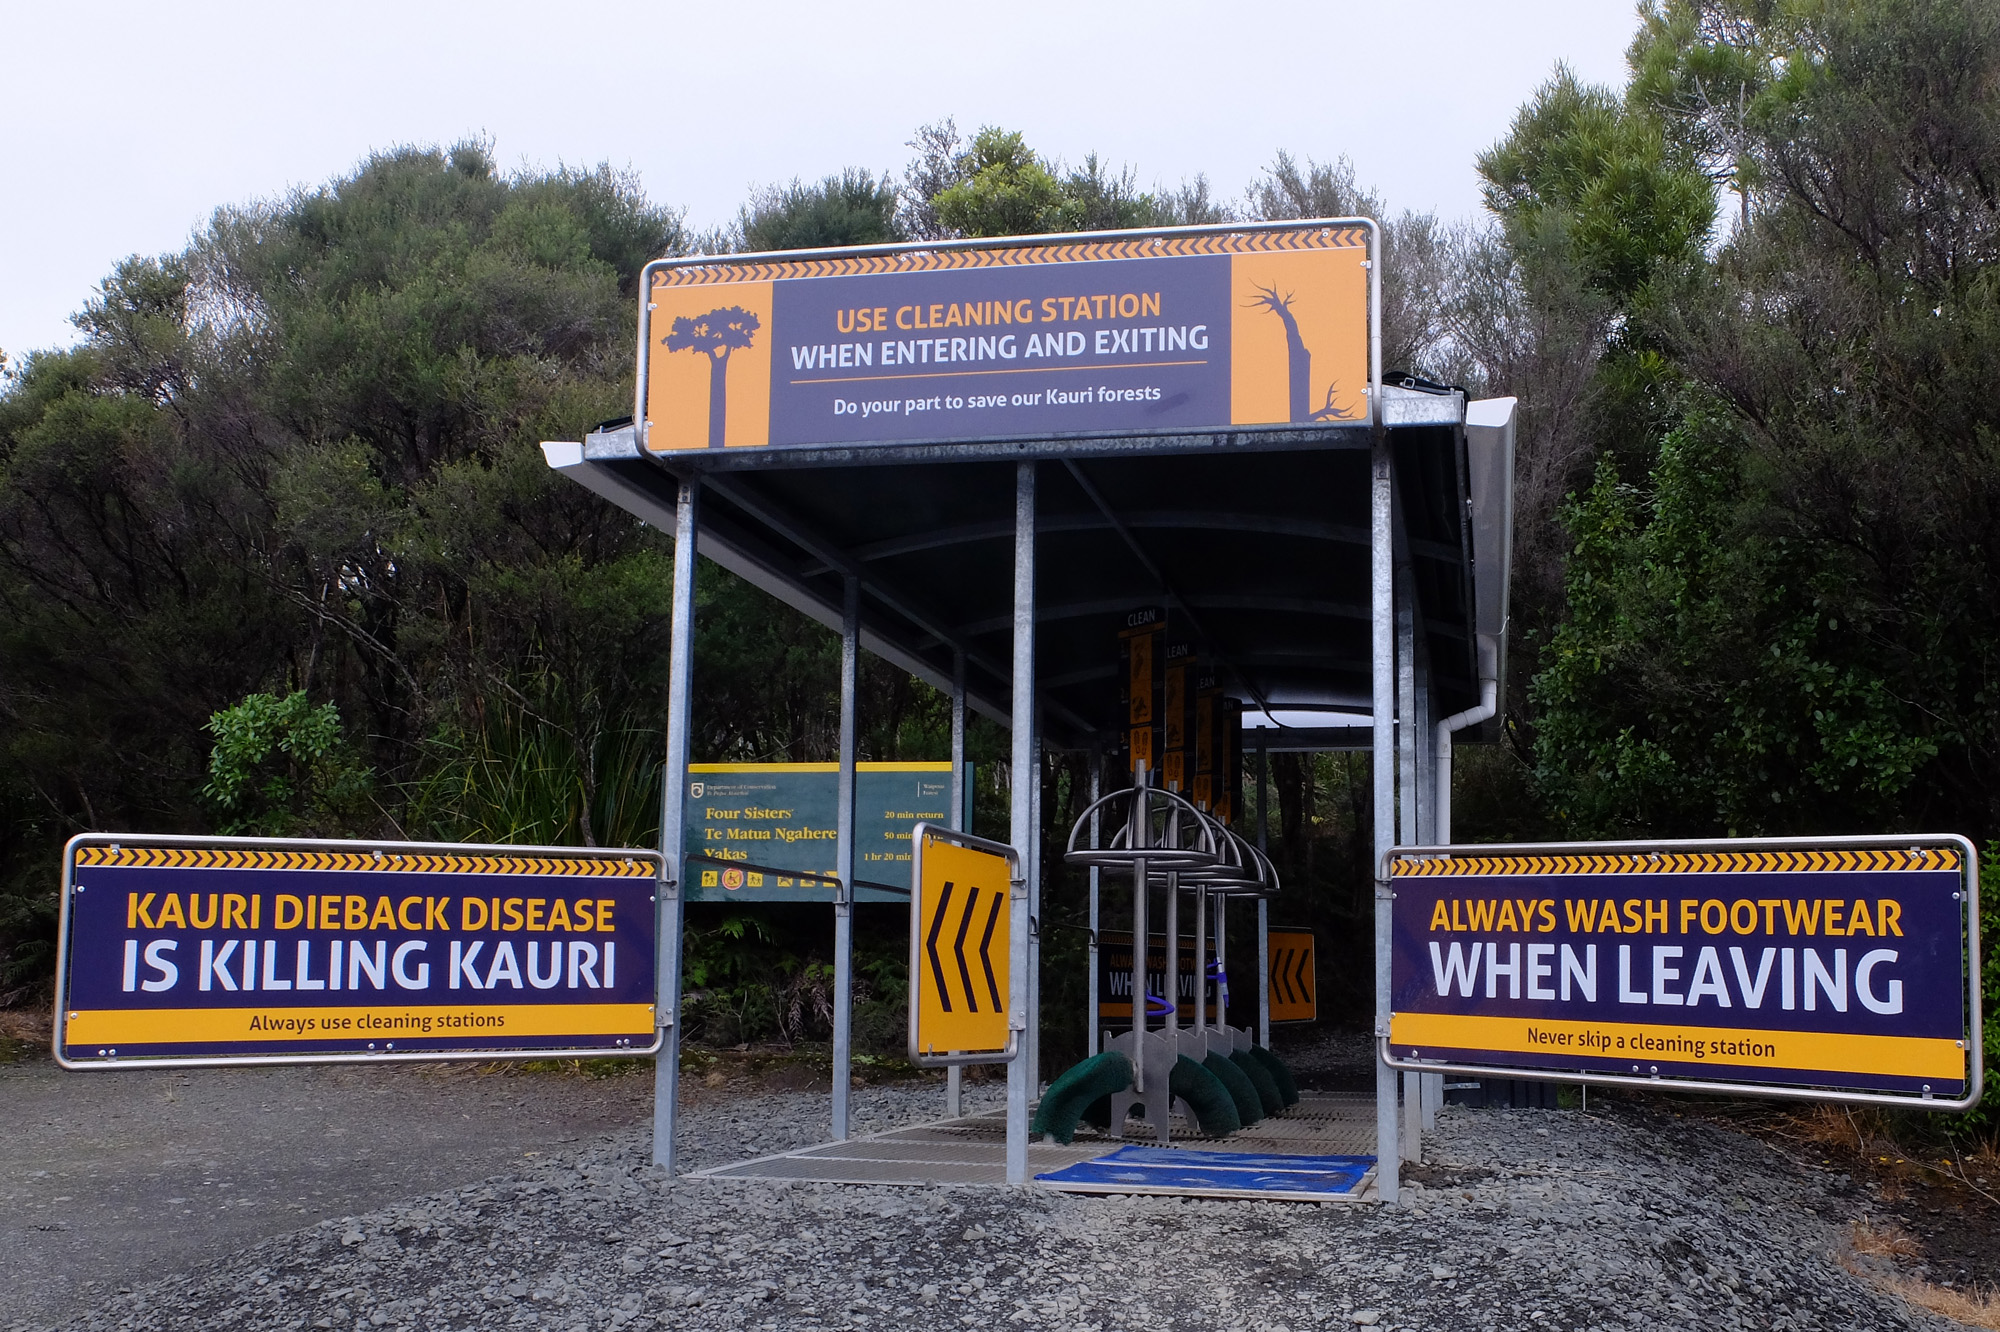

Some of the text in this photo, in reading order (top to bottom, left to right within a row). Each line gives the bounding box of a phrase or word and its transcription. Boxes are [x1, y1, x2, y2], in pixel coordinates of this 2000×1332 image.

[838, 293, 1160, 333] USE CLEANING STATION
[791, 325, 1208, 369] WHEN ENTERING AND EXITING
[835, 386, 1160, 417] Do your part to save our Kauri forests
[1127, 608, 1156, 627] CLEAN
[1166, 643, 1188, 659] LEAN
[1199, 675, 1216, 689] EAN
[705, 807, 741, 819] Four
[884, 810, 945, 819] 20 min return
[704, 826, 837, 843] Te Matua Ngahere
[884, 832, 895, 840] 50
[703, 847, 748, 860] Yakas
[871, 852, 882, 861] hr
[884, 852, 894, 861] 20
[128, 893, 615, 931] KAURI DIEBACK DISEASE
[1430, 899, 1903, 936] ALWAYS WASH FOOTWEAR
[123, 940, 614, 992] IS KILLING KAURI
[1109, 953, 1133, 969] ALWA
[1108, 971, 1153, 996] WHN
[1429, 942, 1902, 1014] WHEN LEAVING
[250, 1012, 504, 1034] Always use cleaning stations
[1528, 1028, 1774, 1058] Never skip a cleaning station
